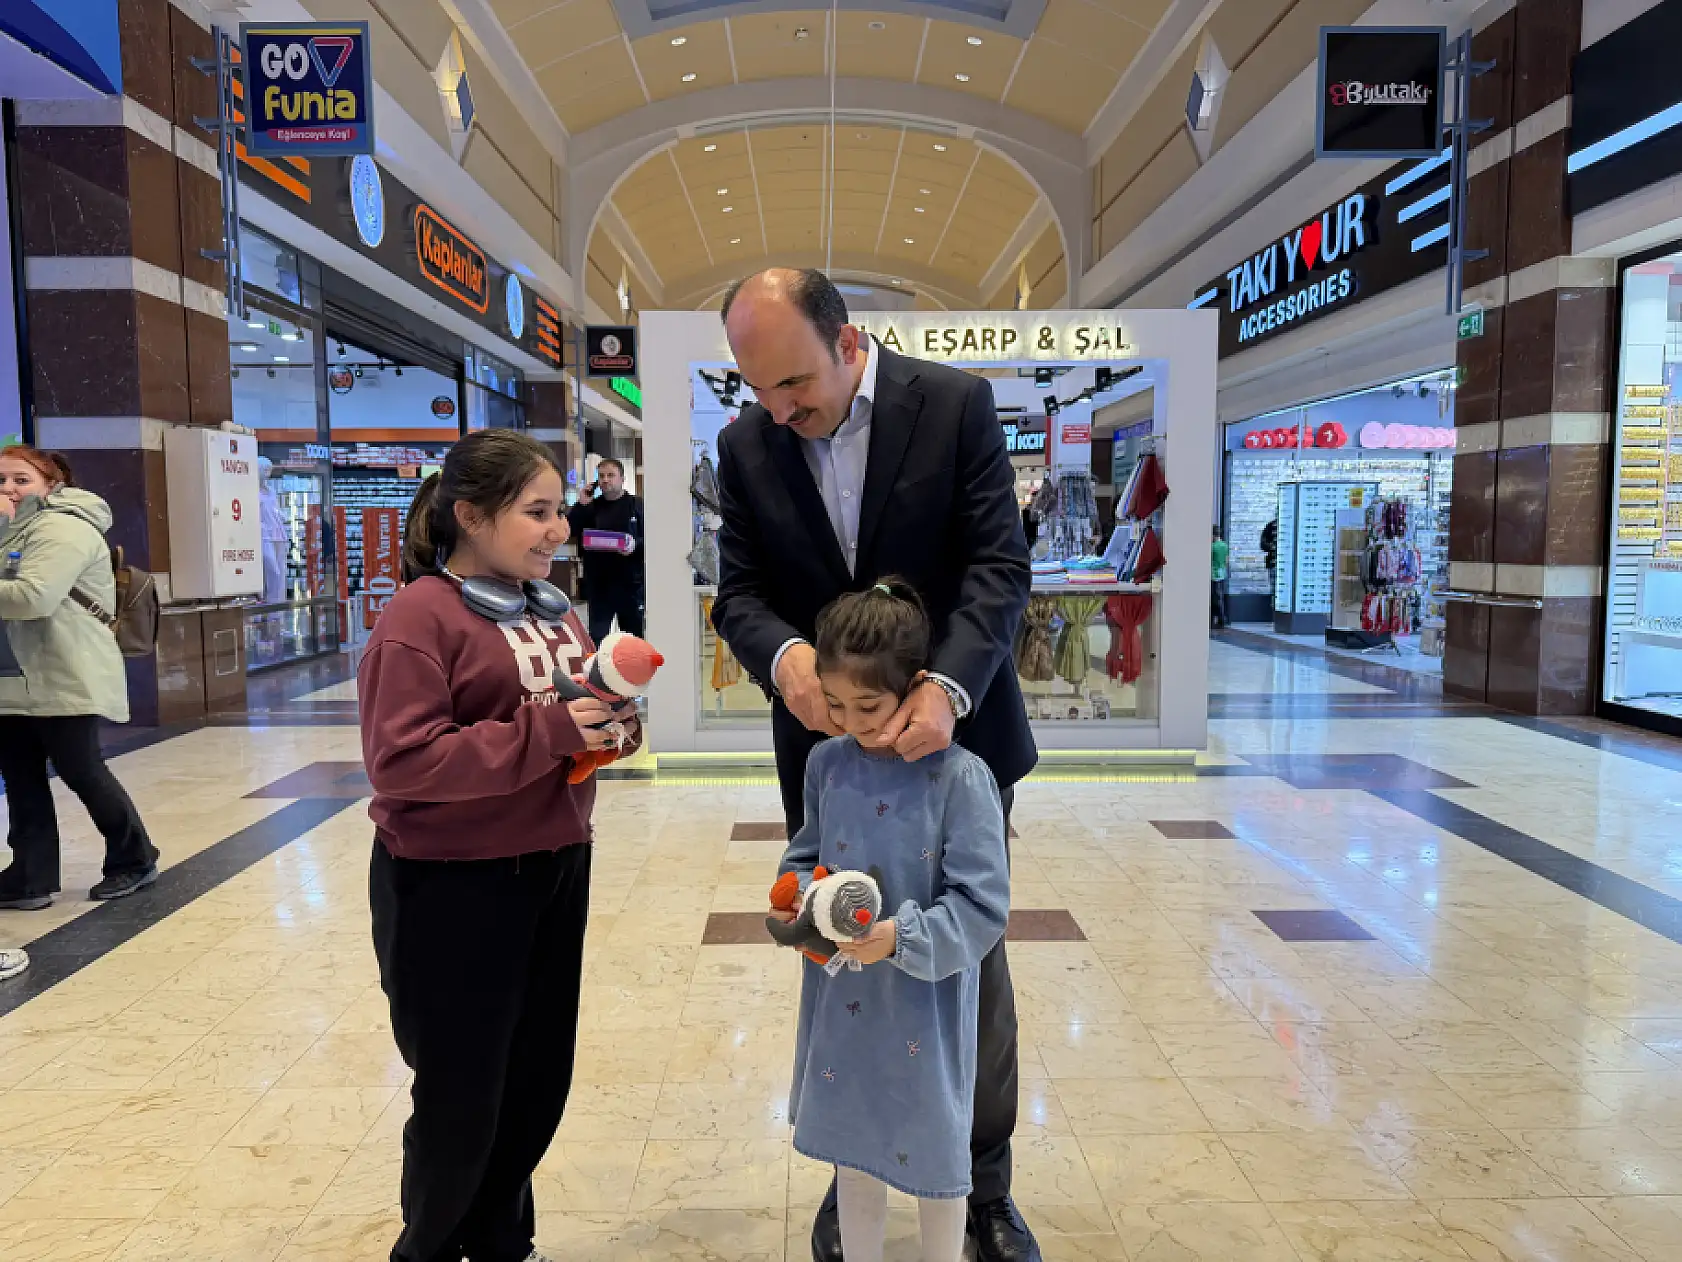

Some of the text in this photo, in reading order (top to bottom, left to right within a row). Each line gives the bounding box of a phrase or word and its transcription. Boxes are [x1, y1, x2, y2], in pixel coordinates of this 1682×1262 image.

[261, 43, 310, 80] GO
[422, 216, 484, 296] Kaplanlar
[1238, 268, 1350, 343] ACCESSORIES
[924, 327, 1017, 356] EŞARP
[1037, 325, 1056, 350] &
[1075, 326, 1131, 354] ŞAL
[232, 498, 242, 521] 9
